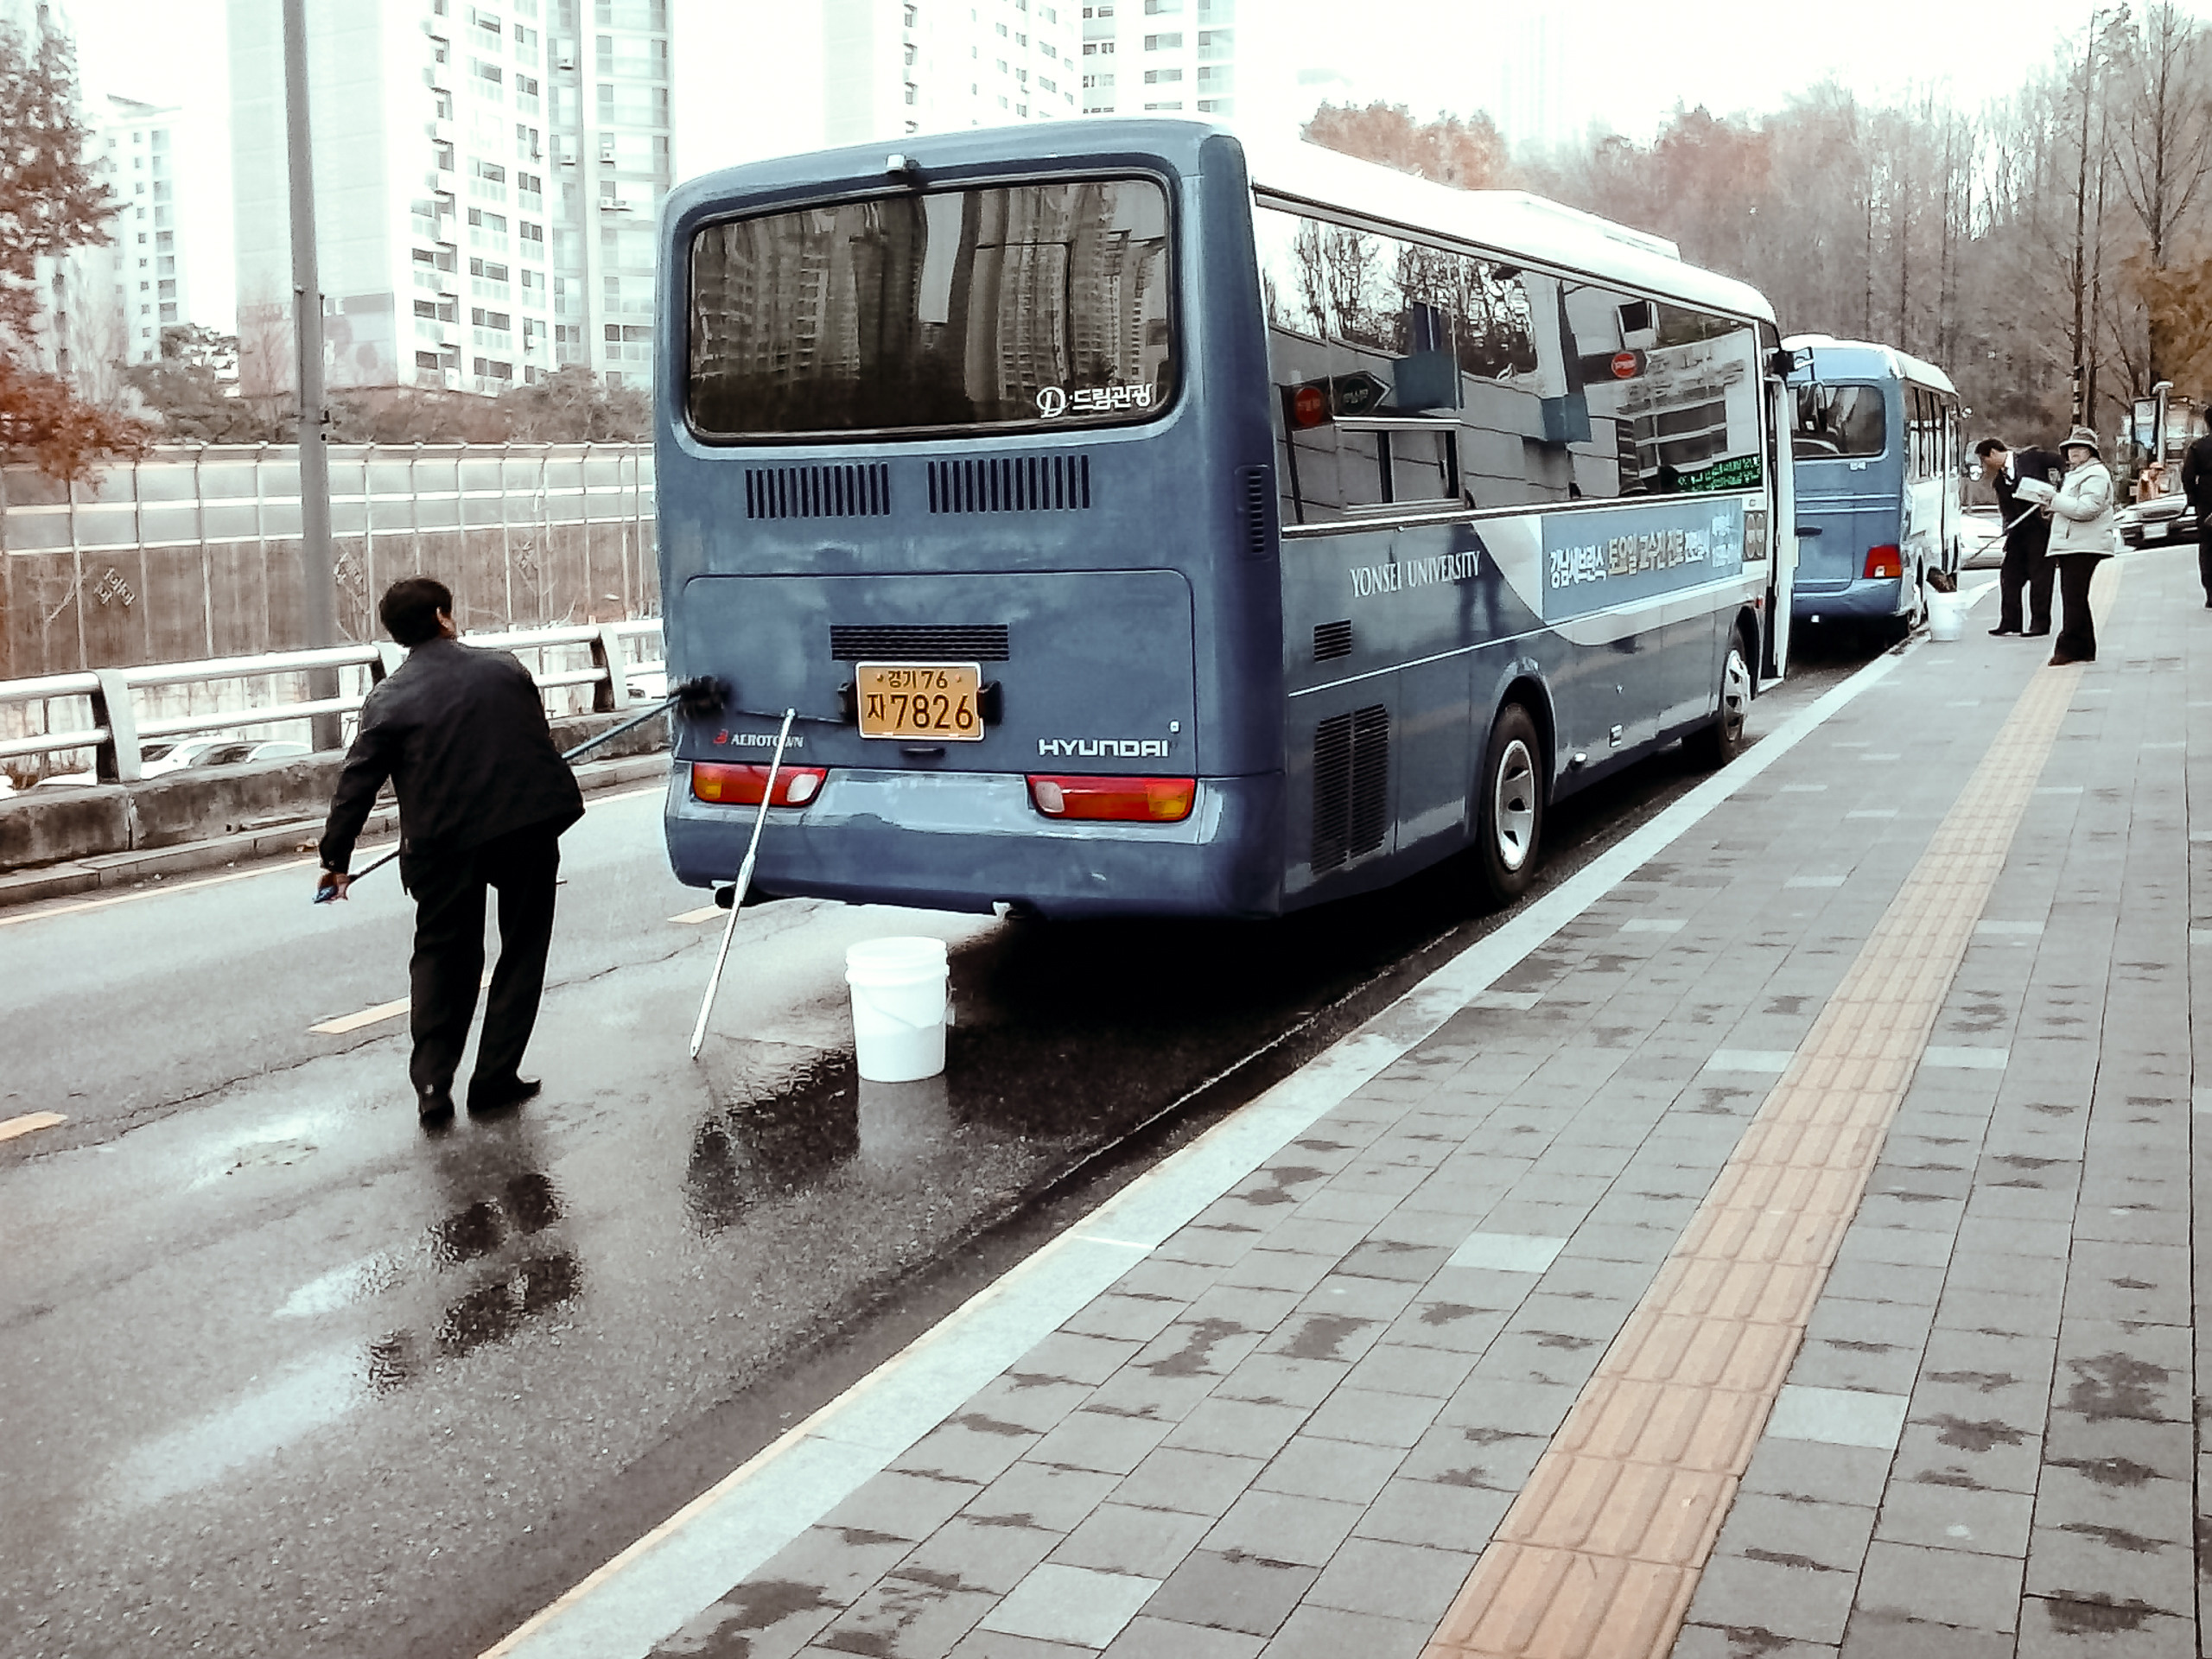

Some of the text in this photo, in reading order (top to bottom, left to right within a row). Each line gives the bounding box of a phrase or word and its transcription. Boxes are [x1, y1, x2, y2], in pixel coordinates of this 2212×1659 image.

[1350, 550, 1481, 598] YONSEI UNIVERSITY
[1038, 737, 1169, 758] HYUNDAI
